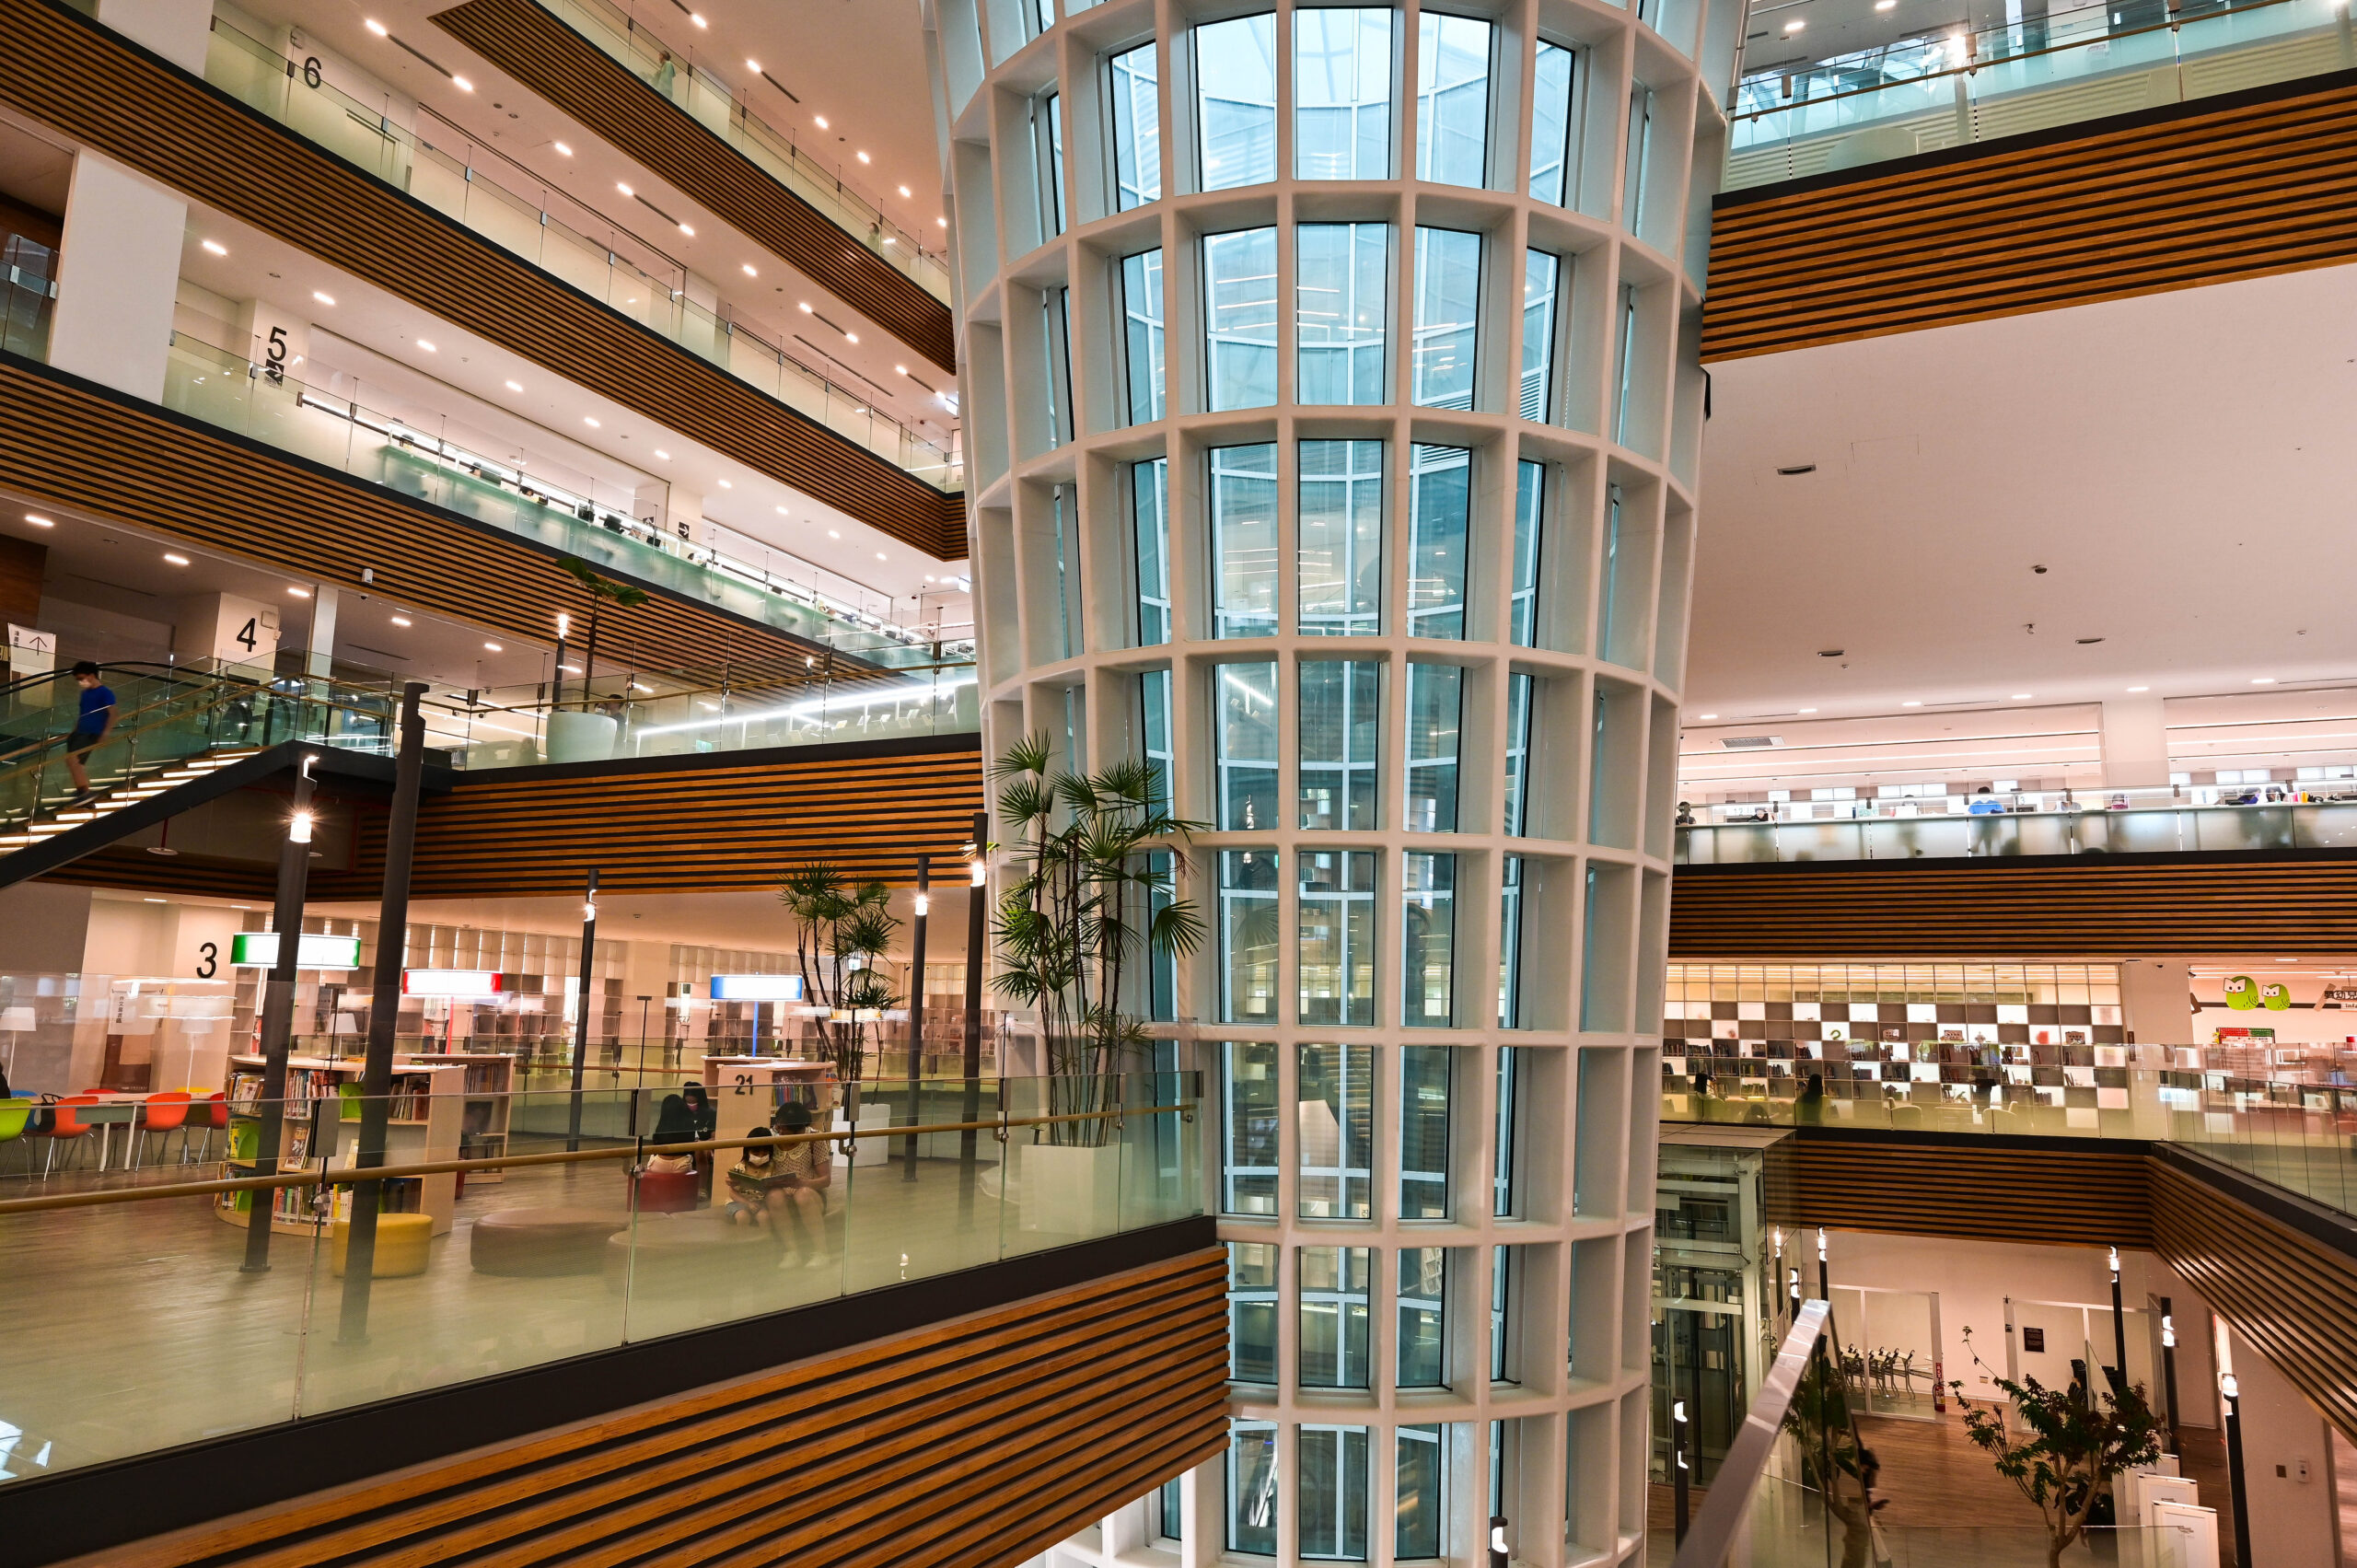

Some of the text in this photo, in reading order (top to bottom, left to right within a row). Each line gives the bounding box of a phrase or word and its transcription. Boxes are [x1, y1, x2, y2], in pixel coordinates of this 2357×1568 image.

[304, 56, 322, 89] 6
[267, 326, 287, 362] 5
[236, 618, 257, 653] 4
[196, 942, 218, 979] 3
[735, 1074, 753, 1096] 21
